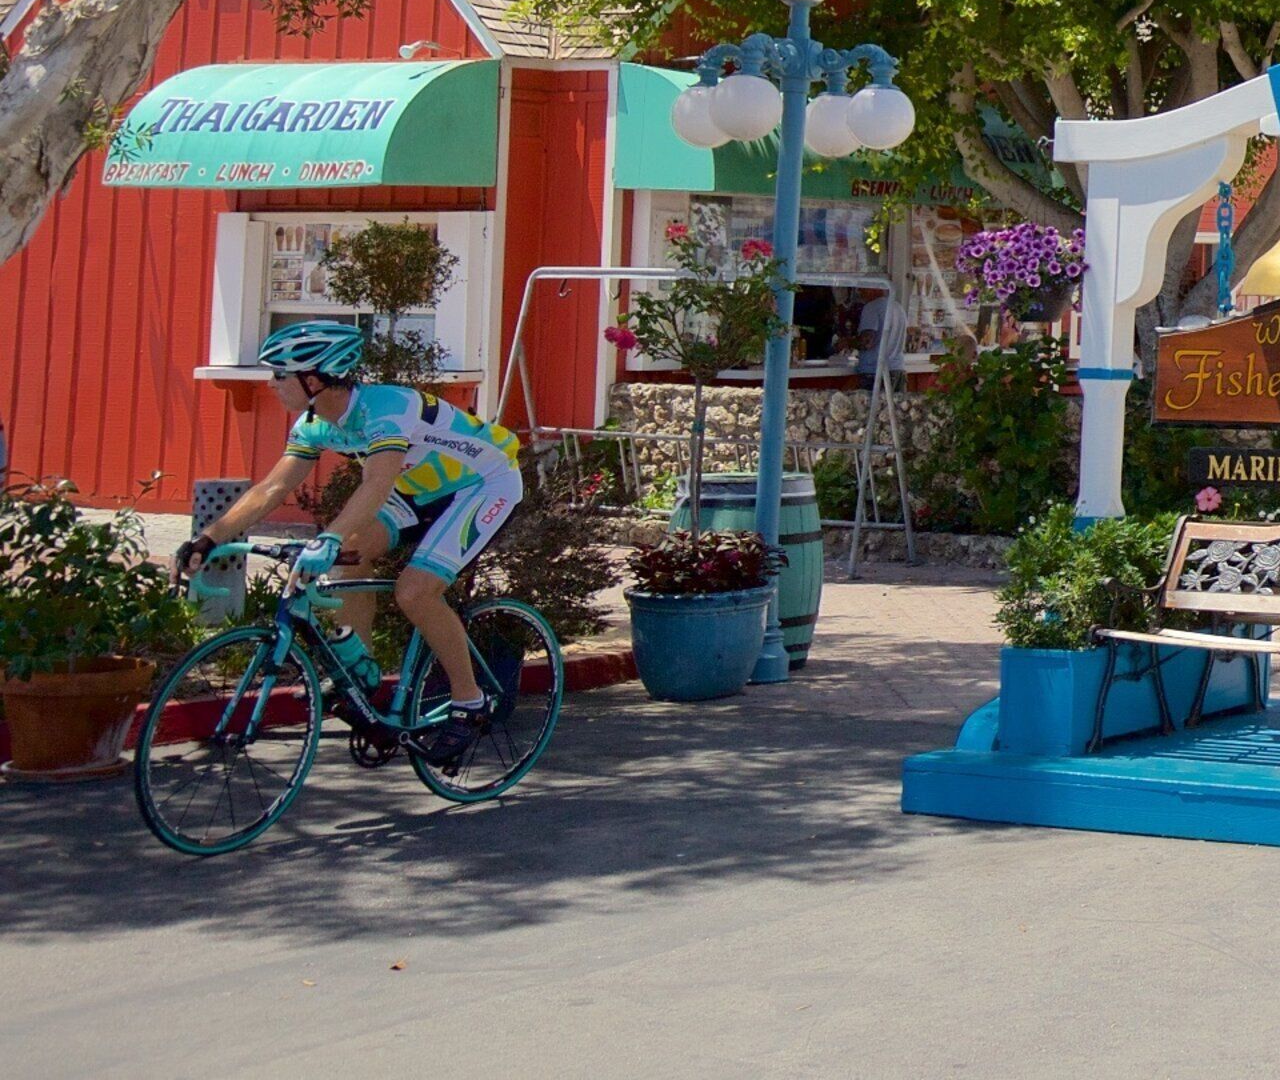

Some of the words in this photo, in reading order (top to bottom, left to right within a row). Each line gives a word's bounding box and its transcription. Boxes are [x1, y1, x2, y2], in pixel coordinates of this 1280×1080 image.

[103, 162, 193, 183] BREAKFAST
[214, 161, 276, 183] LUNCH
[298, 159, 367, 182] DINNER
[852, 179, 916, 198] BREAKS
[481, 497, 508, 525] DCM
